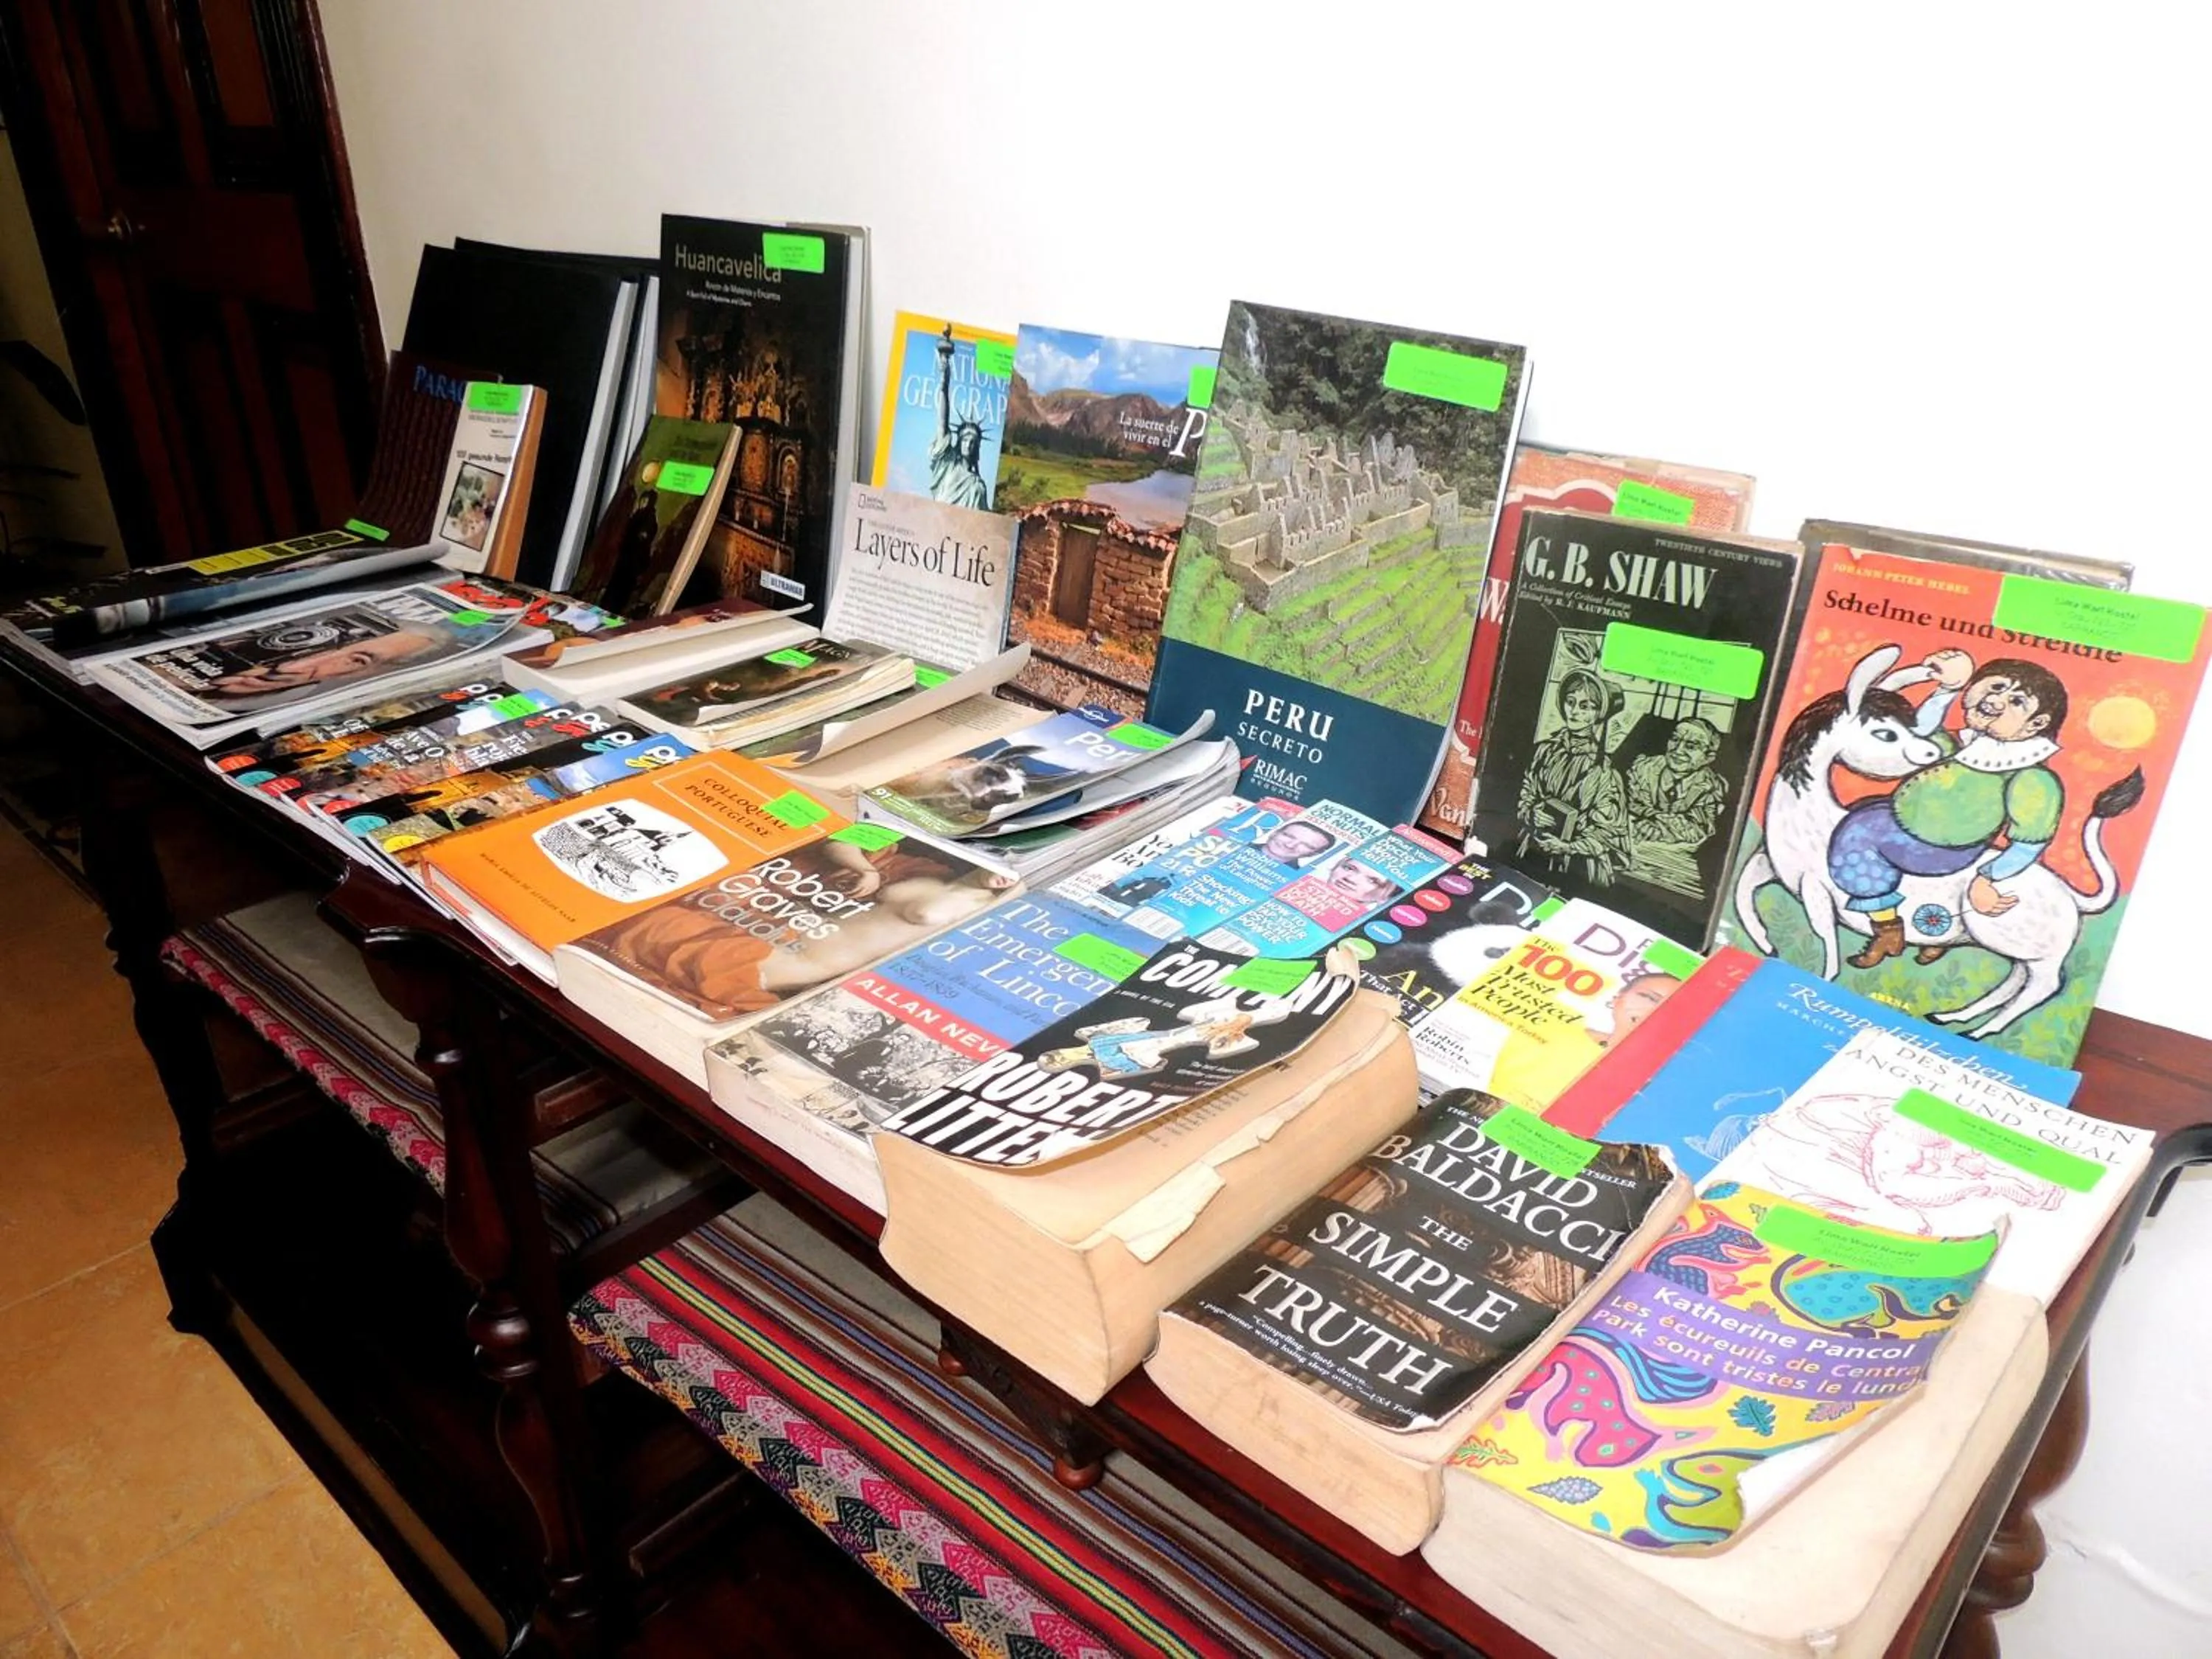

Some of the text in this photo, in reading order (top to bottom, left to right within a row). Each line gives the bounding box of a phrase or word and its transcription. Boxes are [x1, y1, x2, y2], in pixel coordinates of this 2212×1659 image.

[1119, 411, 1133, 425] La
[1166, 419, 1179, 435] de
[1123, 429, 1146, 443] vivir
[1147, 434, 1160, 447] en
[855, 518, 995, 586] Layers of Life
[1525, 537, 1718, 609] G. B. SHAW
[1708, 546, 1748, 562] CENTURY
[1528, 582, 1563, 597] Collection
[1565, 590, 1573, 599] of
[1573, 591, 1601, 605] Critical
[1833, 563, 1969, 595] JOHANN PETER HEBEL
[1576, 602, 1631, 620] KAUFMANN
[1823, 589, 1933, 627] Schelme
[1940, 614, 1994, 640] und
[1244, 689, 1334, 742] PERU
[1237, 721, 1324, 764] SECRETO
[1254, 759, 1307, 790] RIMAC
[685, 785, 773, 838] PORTUGUESE
[1311, 810, 1332, 823] OR
[1320, 804, 1381, 835] NORMAL
[1236, 854, 1290, 883] Williams
[1245, 847, 1279, 868] Robin
[719, 874, 839, 939] Graves
[749, 858, 875, 919] Robert
[1000, 900, 1069, 940] The
[928, 939, 984, 965] of
[978, 959, 1082, 1018] Linco
[960, 919, 1117, 995] Emergen
[1495, 964, 1556, 996] Most
[1515, 944, 1604, 998] 100
[855, 978, 943, 1030] ALLAN
[1469, 1000, 1548, 1045] America Today
[1472, 984, 1550, 1027] People
[1484, 973, 1584, 1025] Trusted
[1416, 1033, 1470, 1065] Roberts
[1422, 1026, 1464, 1052] Robin
[956, 1052, 1192, 1127] ROBERT
[1447, 1105, 1469, 1119] THE
[1846, 1048, 1946, 1092] ANGST
[1955, 1093, 2022, 1127] UND
[2037, 1128, 2123, 1164] QUAL
[1896, 1047, 2138, 1144] DES MENSCHEN
[1438, 1120, 1598, 1208] DAVID
[1372, 1135, 1626, 1261] BALDACCI
[1418, 1215, 1472, 1252] THE
[1307, 1211, 1520, 1334] SIMPLE
[1204, 1302, 1253, 1330] page-turner
[1254, 1329, 1280, 1349] worth
[1280, 1344, 1307, 1363] losing
[1307, 1360, 1330, 1376] sleep
[1238, 1263, 1453, 1396] TRUTH
[1610, 1295, 1652, 1318] Les
[1659, 1314, 1775, 1367] écureuils
[1785, 1358, 1820, 1373] de
[1653, 1286, 1916, 1359] Katherine Pancol
[1592, 1310, 1648, 1338] Park
[1653, 1335, 1715, 1366] sont
[1723, 1359, 1808, 1391] tristes
[1816, 1379, 1842, 1394] le
